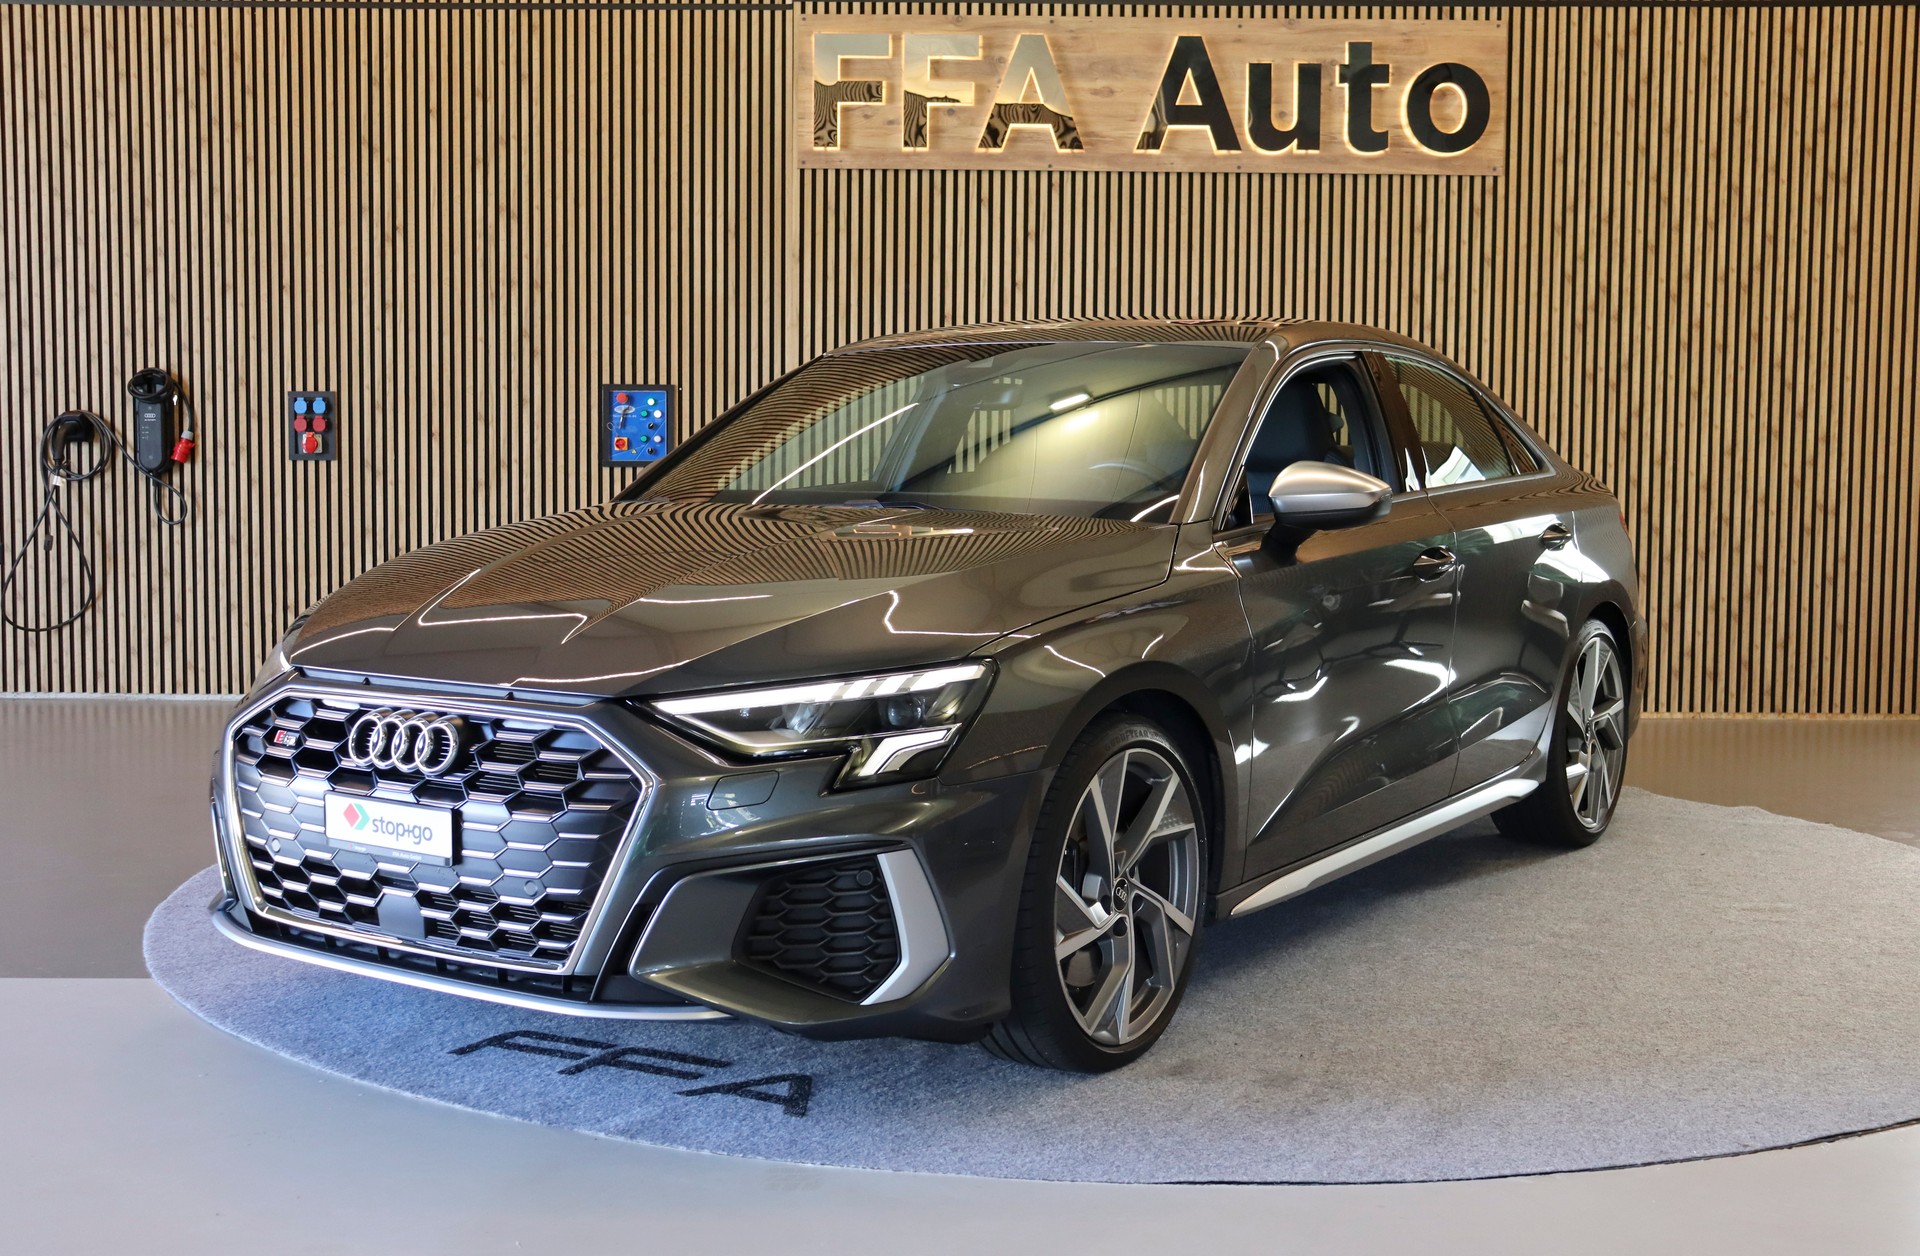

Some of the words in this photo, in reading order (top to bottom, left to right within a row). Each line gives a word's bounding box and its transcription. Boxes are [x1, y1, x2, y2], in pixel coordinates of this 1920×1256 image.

[813, 33, 1085, 151] FFA
[1136, 35, 1492, 154] Auto
[372, 816, 433, 845] stop+go
[447, 1029, 813, 1118] FFA
